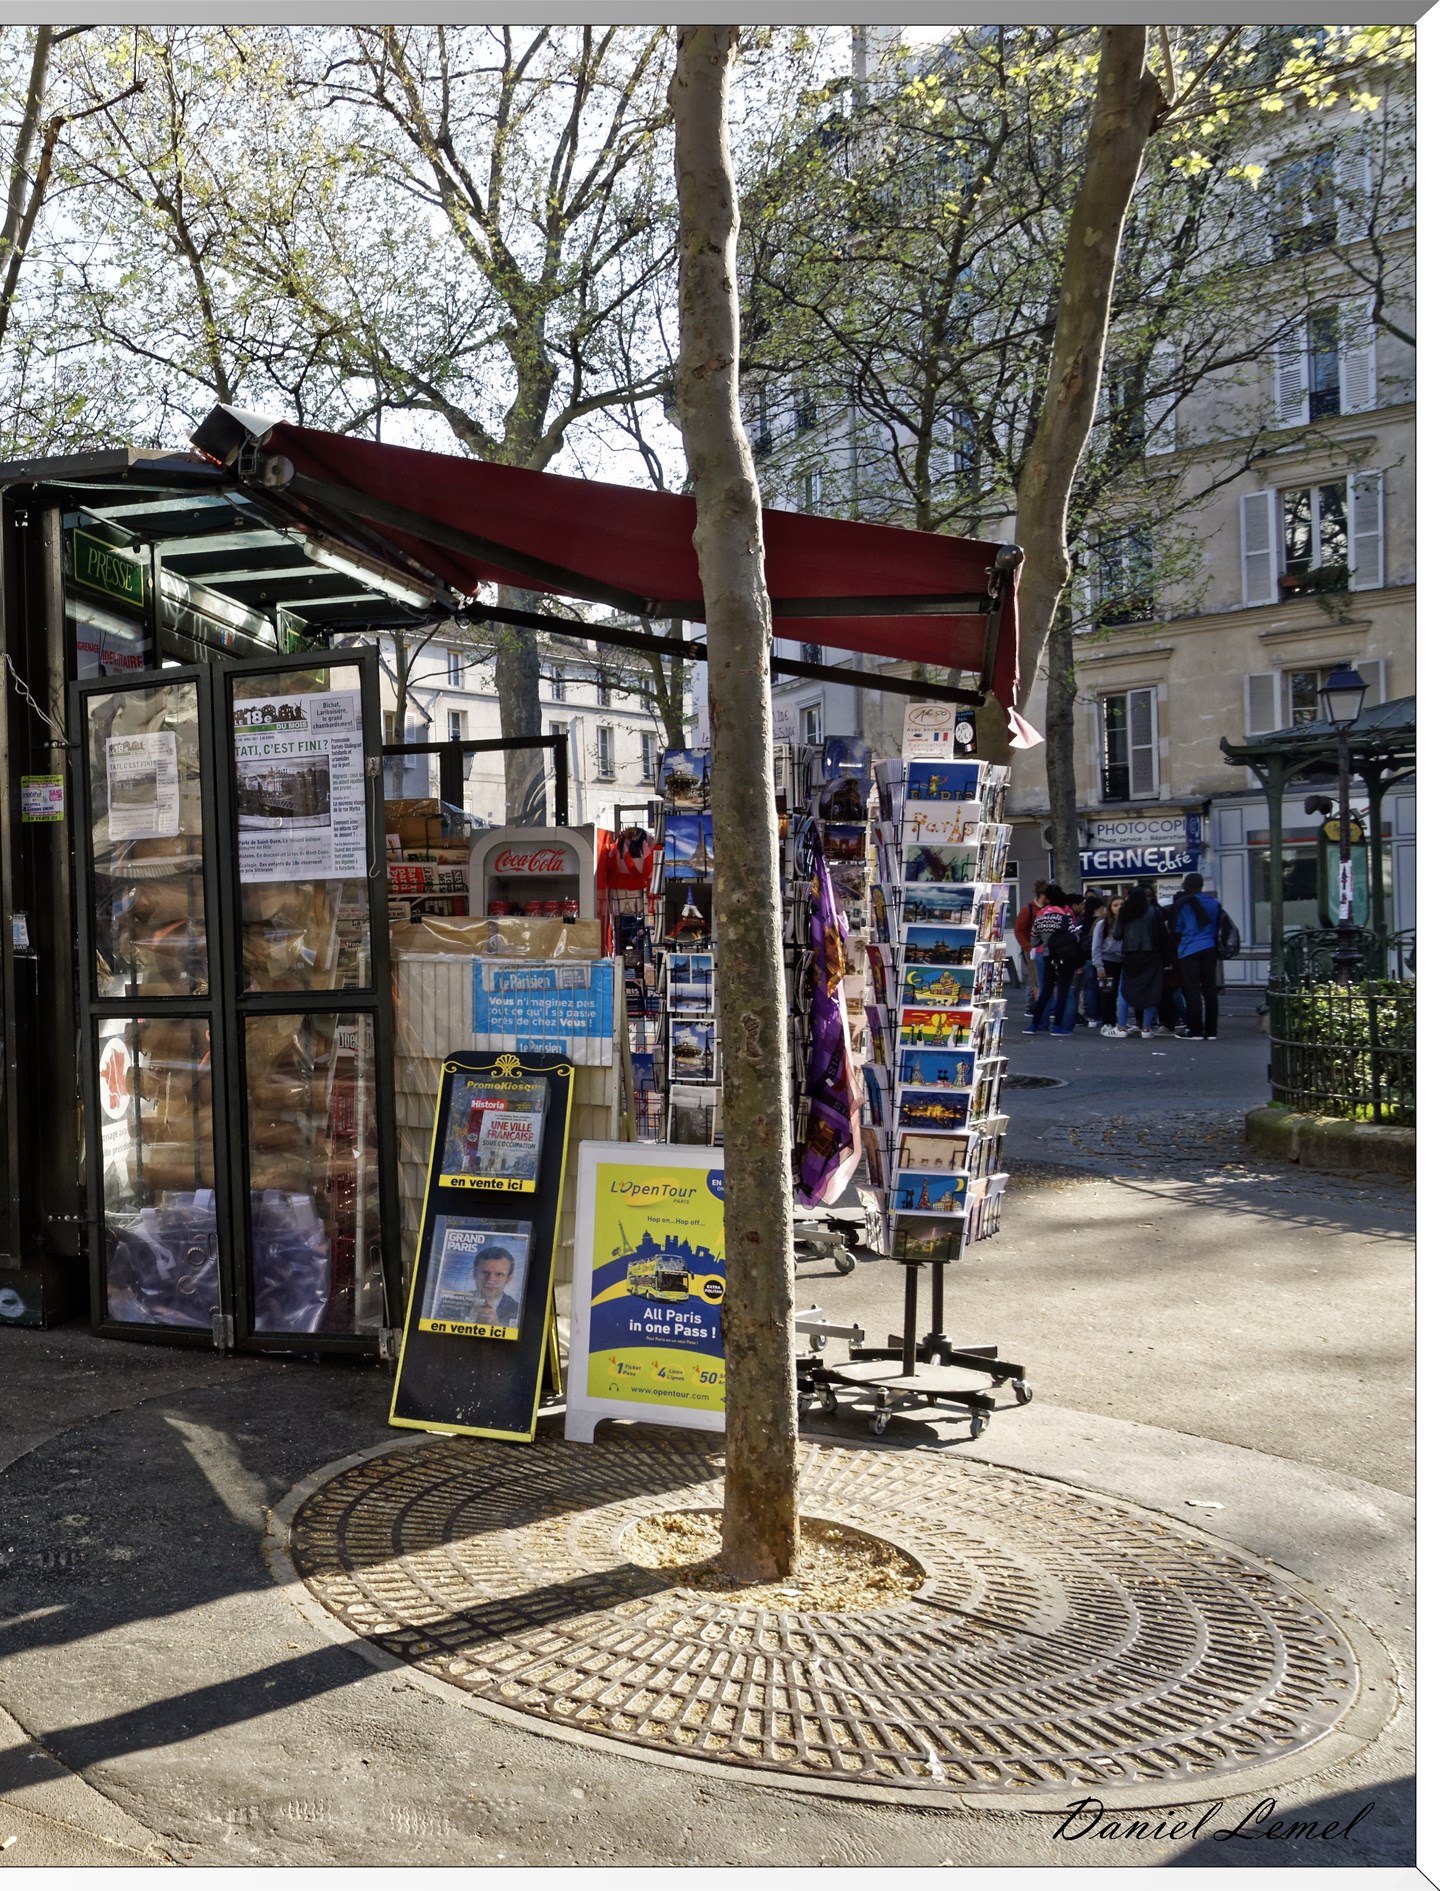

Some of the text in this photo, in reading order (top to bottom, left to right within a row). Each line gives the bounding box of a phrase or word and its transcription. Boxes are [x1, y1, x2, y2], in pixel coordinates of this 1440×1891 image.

[86, 547, 133, 593] PRESSE
[245, 710, 273, 725] 18e
[328, 714, 343, 723] grand
[288, 721, 308, 729] MOIS
[312, 720, 353, 729] chambardement
[235, 740, 321, 758] TATI, C'EST FINI
[1097, 819, 1186, 836] PHOTOCOPI
[1098, 833, 1186, 844] Phone service Réparation
[494, 848, 568, 874] Coca-Cola
[1079, 846, 1192, 873] TERNET Café
[499, 977, 509, 989] Le
[509, 972, 551, 990] Parisien
[488, 996, 596, 1008] Vous n'imaginez pas
[488, 1006, 597, 1018] tout ce qu'il se passe
[490, 1016, 587, 1027] près de chez Vous
[520, 1040, 562, 1053] Le Parisien
[471, 1099, 505, 1109] Historia
[491, 1120, 532, 1132] UNE VILLE
[450, 1177, 523, 1191] en vente ici
[448, 1232, 485, 1244] GRAND
[447, 1241, 478, 1253] PARIS
[643, 1307, 702, 1324] All Paris
[430, 1322, 506, 1338] en vente ici
[629, 1319, 708, 1339] in one Pass
[617, 1362, 624, 1374] 1
[657, 1366, 666, 1379] 4
[699, 1371, 718, 1385] 50
[631, 1386, 709, 1401] www.opentour.com
